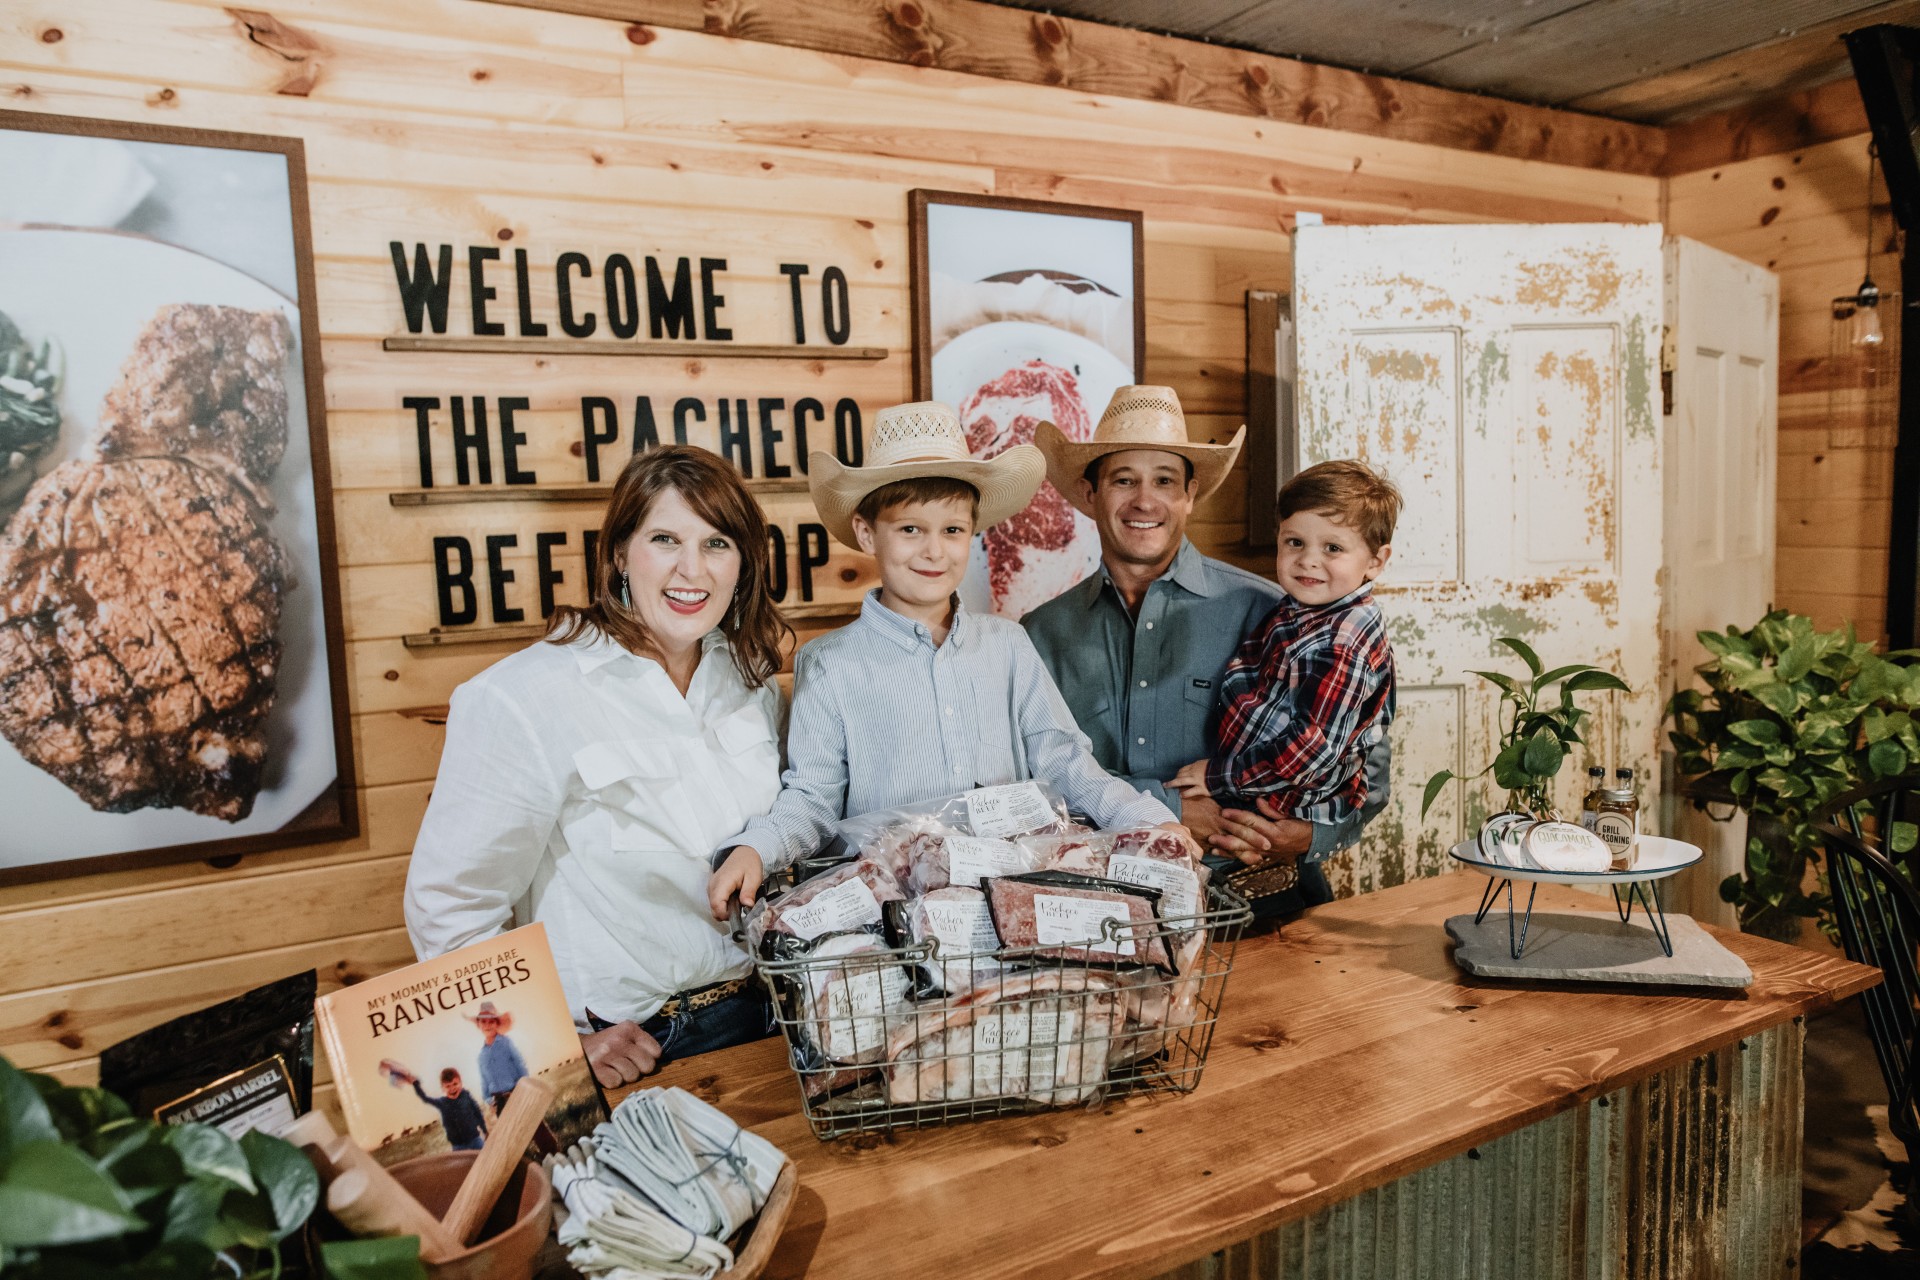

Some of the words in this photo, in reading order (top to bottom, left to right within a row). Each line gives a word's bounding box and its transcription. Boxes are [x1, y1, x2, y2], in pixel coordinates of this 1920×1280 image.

[389, 241, 733, 341] WELCOME
[780, 263, 850, 345] TO
[402, 396, 536, 488] THE
[581, 395, 863, 482] PACHECO
[1598, 833, 1630, 845] ASONING
[1602, 825, 1620, 835] GRILL
[1537, 831, 1594, 848] GUACAMOLE
[1111, 862, 1150, 880] Pacheco
[801, 917, 823, 929] BEEF
[367, 995, 388, 1011] MY
[391, 977, 440, 1001] MOMMY
[443, 973, 453, 983] &
[454, 957, 493, 979] DADDY
[497, 948, 519, 964] ARE
[367, 958, 531, 1038] RANCHERS
[840, 1003, 860, 1014] BEF
[231, 1069, 282, 1100] BARREL
